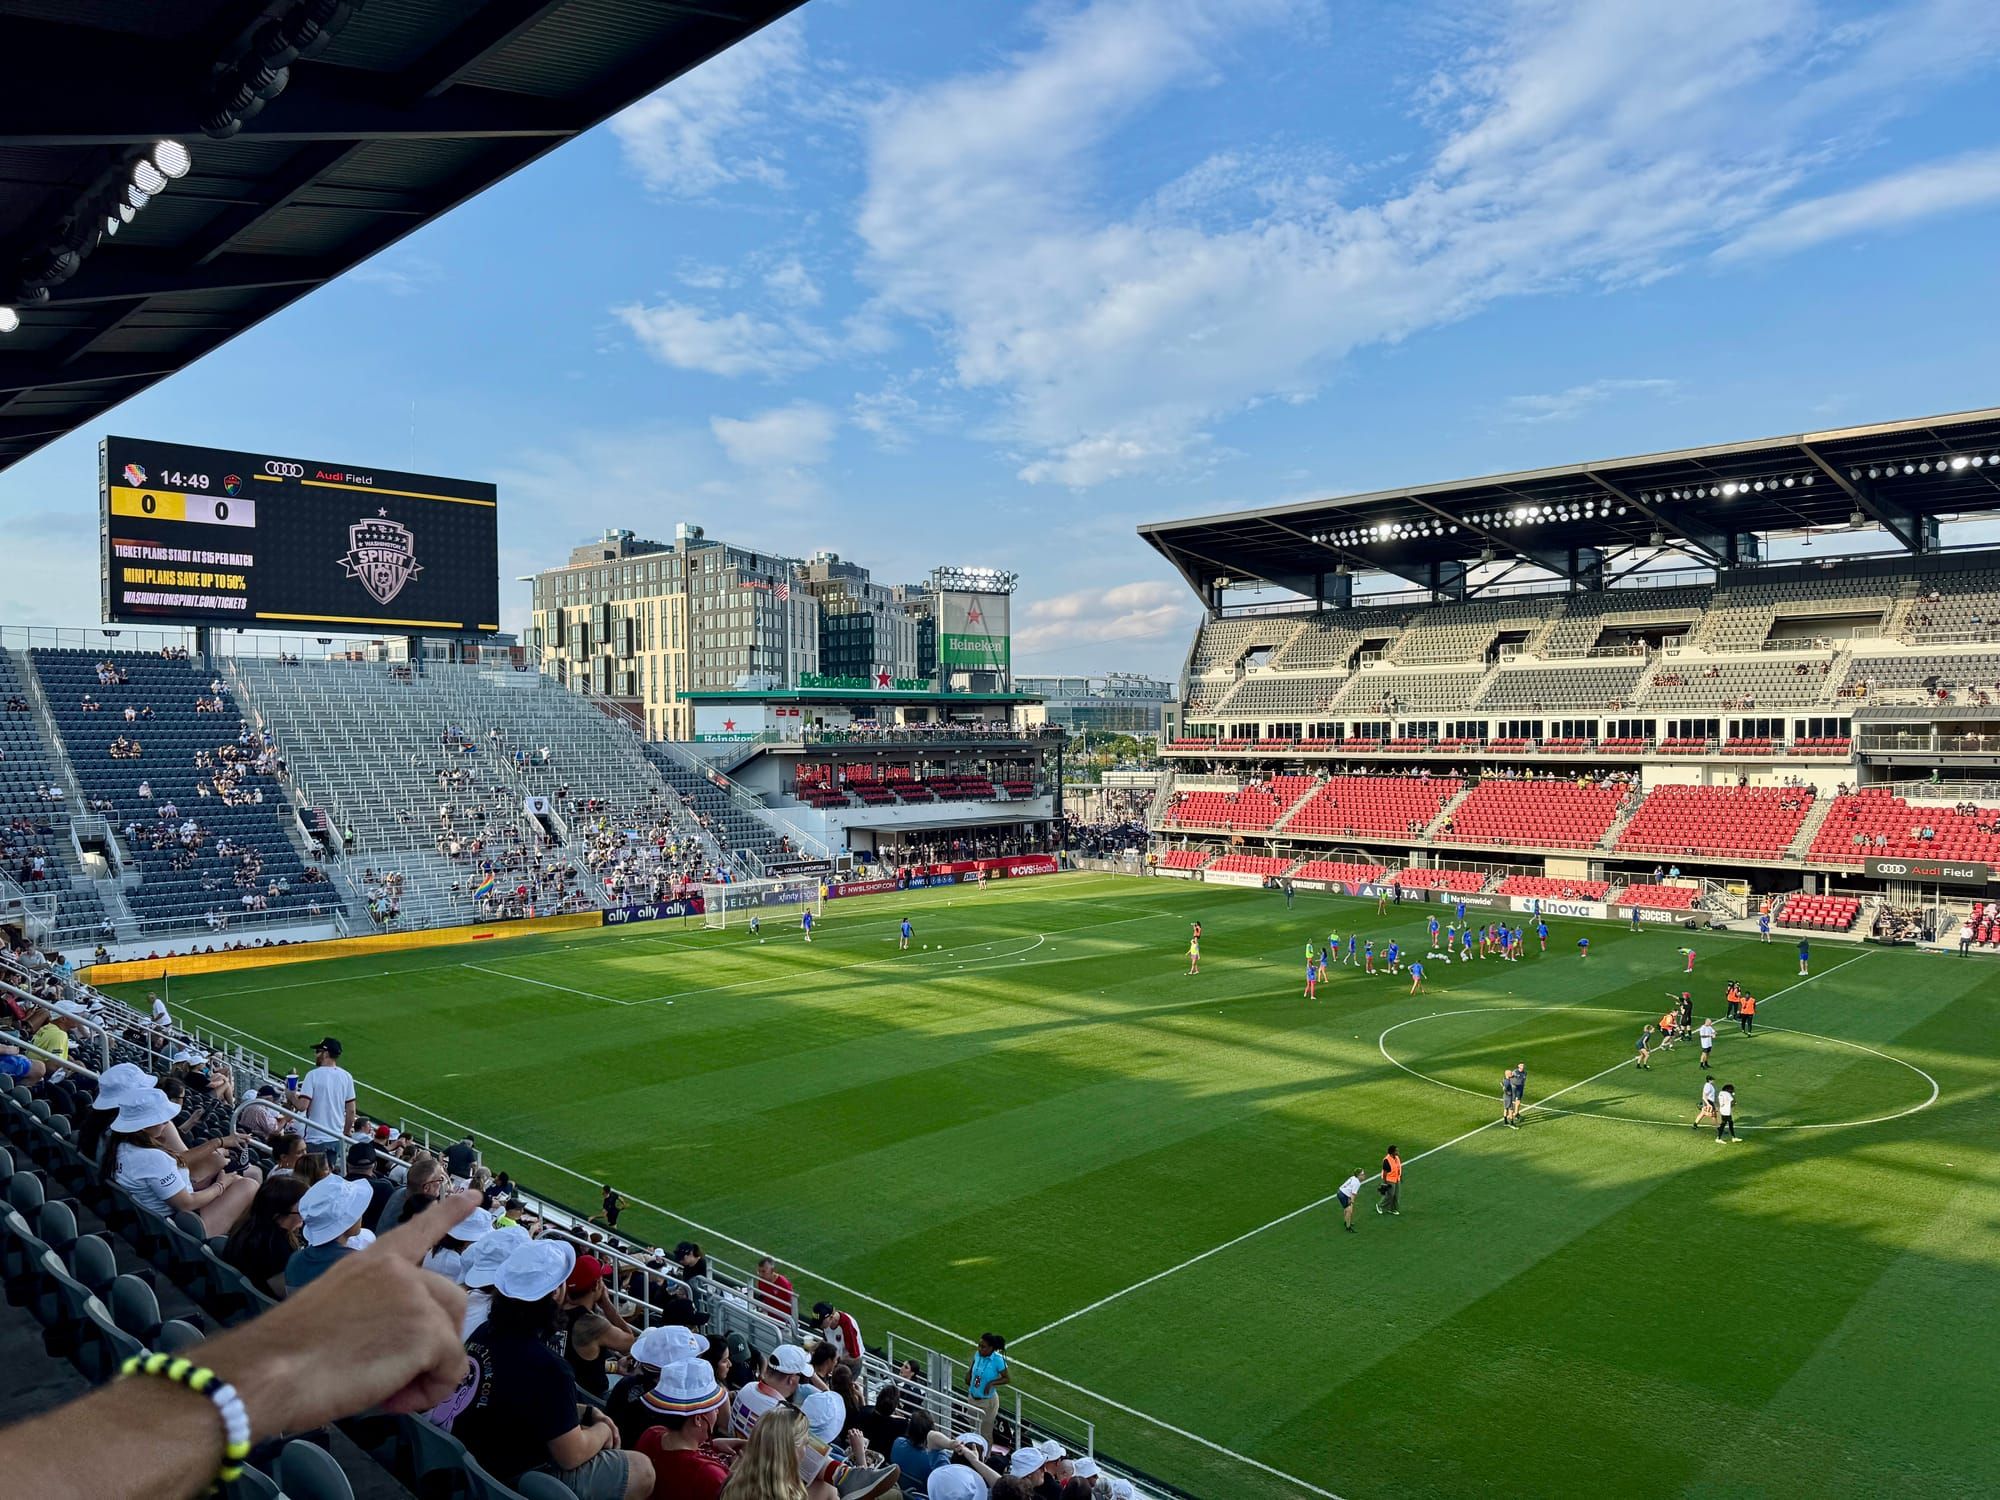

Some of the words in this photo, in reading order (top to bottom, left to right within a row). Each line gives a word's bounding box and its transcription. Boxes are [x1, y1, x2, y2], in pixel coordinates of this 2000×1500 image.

[161, 470, 209, 489] 14:49
[315, 470, 343, 481] Audi
[345, 473, 373, 485] Field
[141, 494, 156, 514] 0
[215, 501, 229, 520] 0
[365, 541, 401, 550] WASHINGTON
[114, 544, 142, 559] TICKET
[143, 547, 168, 561] PLANS
[168, 548, 192, 562] START
[192, 550, 201, 563] AT
[201, 551, 214, 564] $15
[215, 552, 228, 565] PER
[229, 554, 253, 567] MATCH
[358, 550, 407, 566] SPIRIT
[123, 567, 145, 584] MINI
[145, 569, 176, 585] PLANS
[177, 571, 200, 587] SAVE
[201, 573, 213, 588] UP
[214, 574, 226, 589] TO
[227, 575, 246, 590] 50%
[123, 591, 247, 610] WASHINGTONSPIRIT.COM/TICKETS
[949, 638, 1002, 652] Heineken
[799, 672, 871, 689] Heineken
[1911, 866, 1940, 876] Audi
[1943, 868, 1973, 878] Field
[848, 882, 896, 894] NWSLSHOP.COM
[1376, 886, 1419, 900] DETA
[608, 909, 630, 923] ally
[637, 905, 659, 919] ally
[666, 902, 686, 916] ally
[1543, 900, 1590, 917] Inova
[1618, 907, 1637, 919] NIK
[1640, 909, 1672, 923] SOCCER
[160, 1172, 177, 1185] aws
[476, 1382, 491, 1409] COOL
